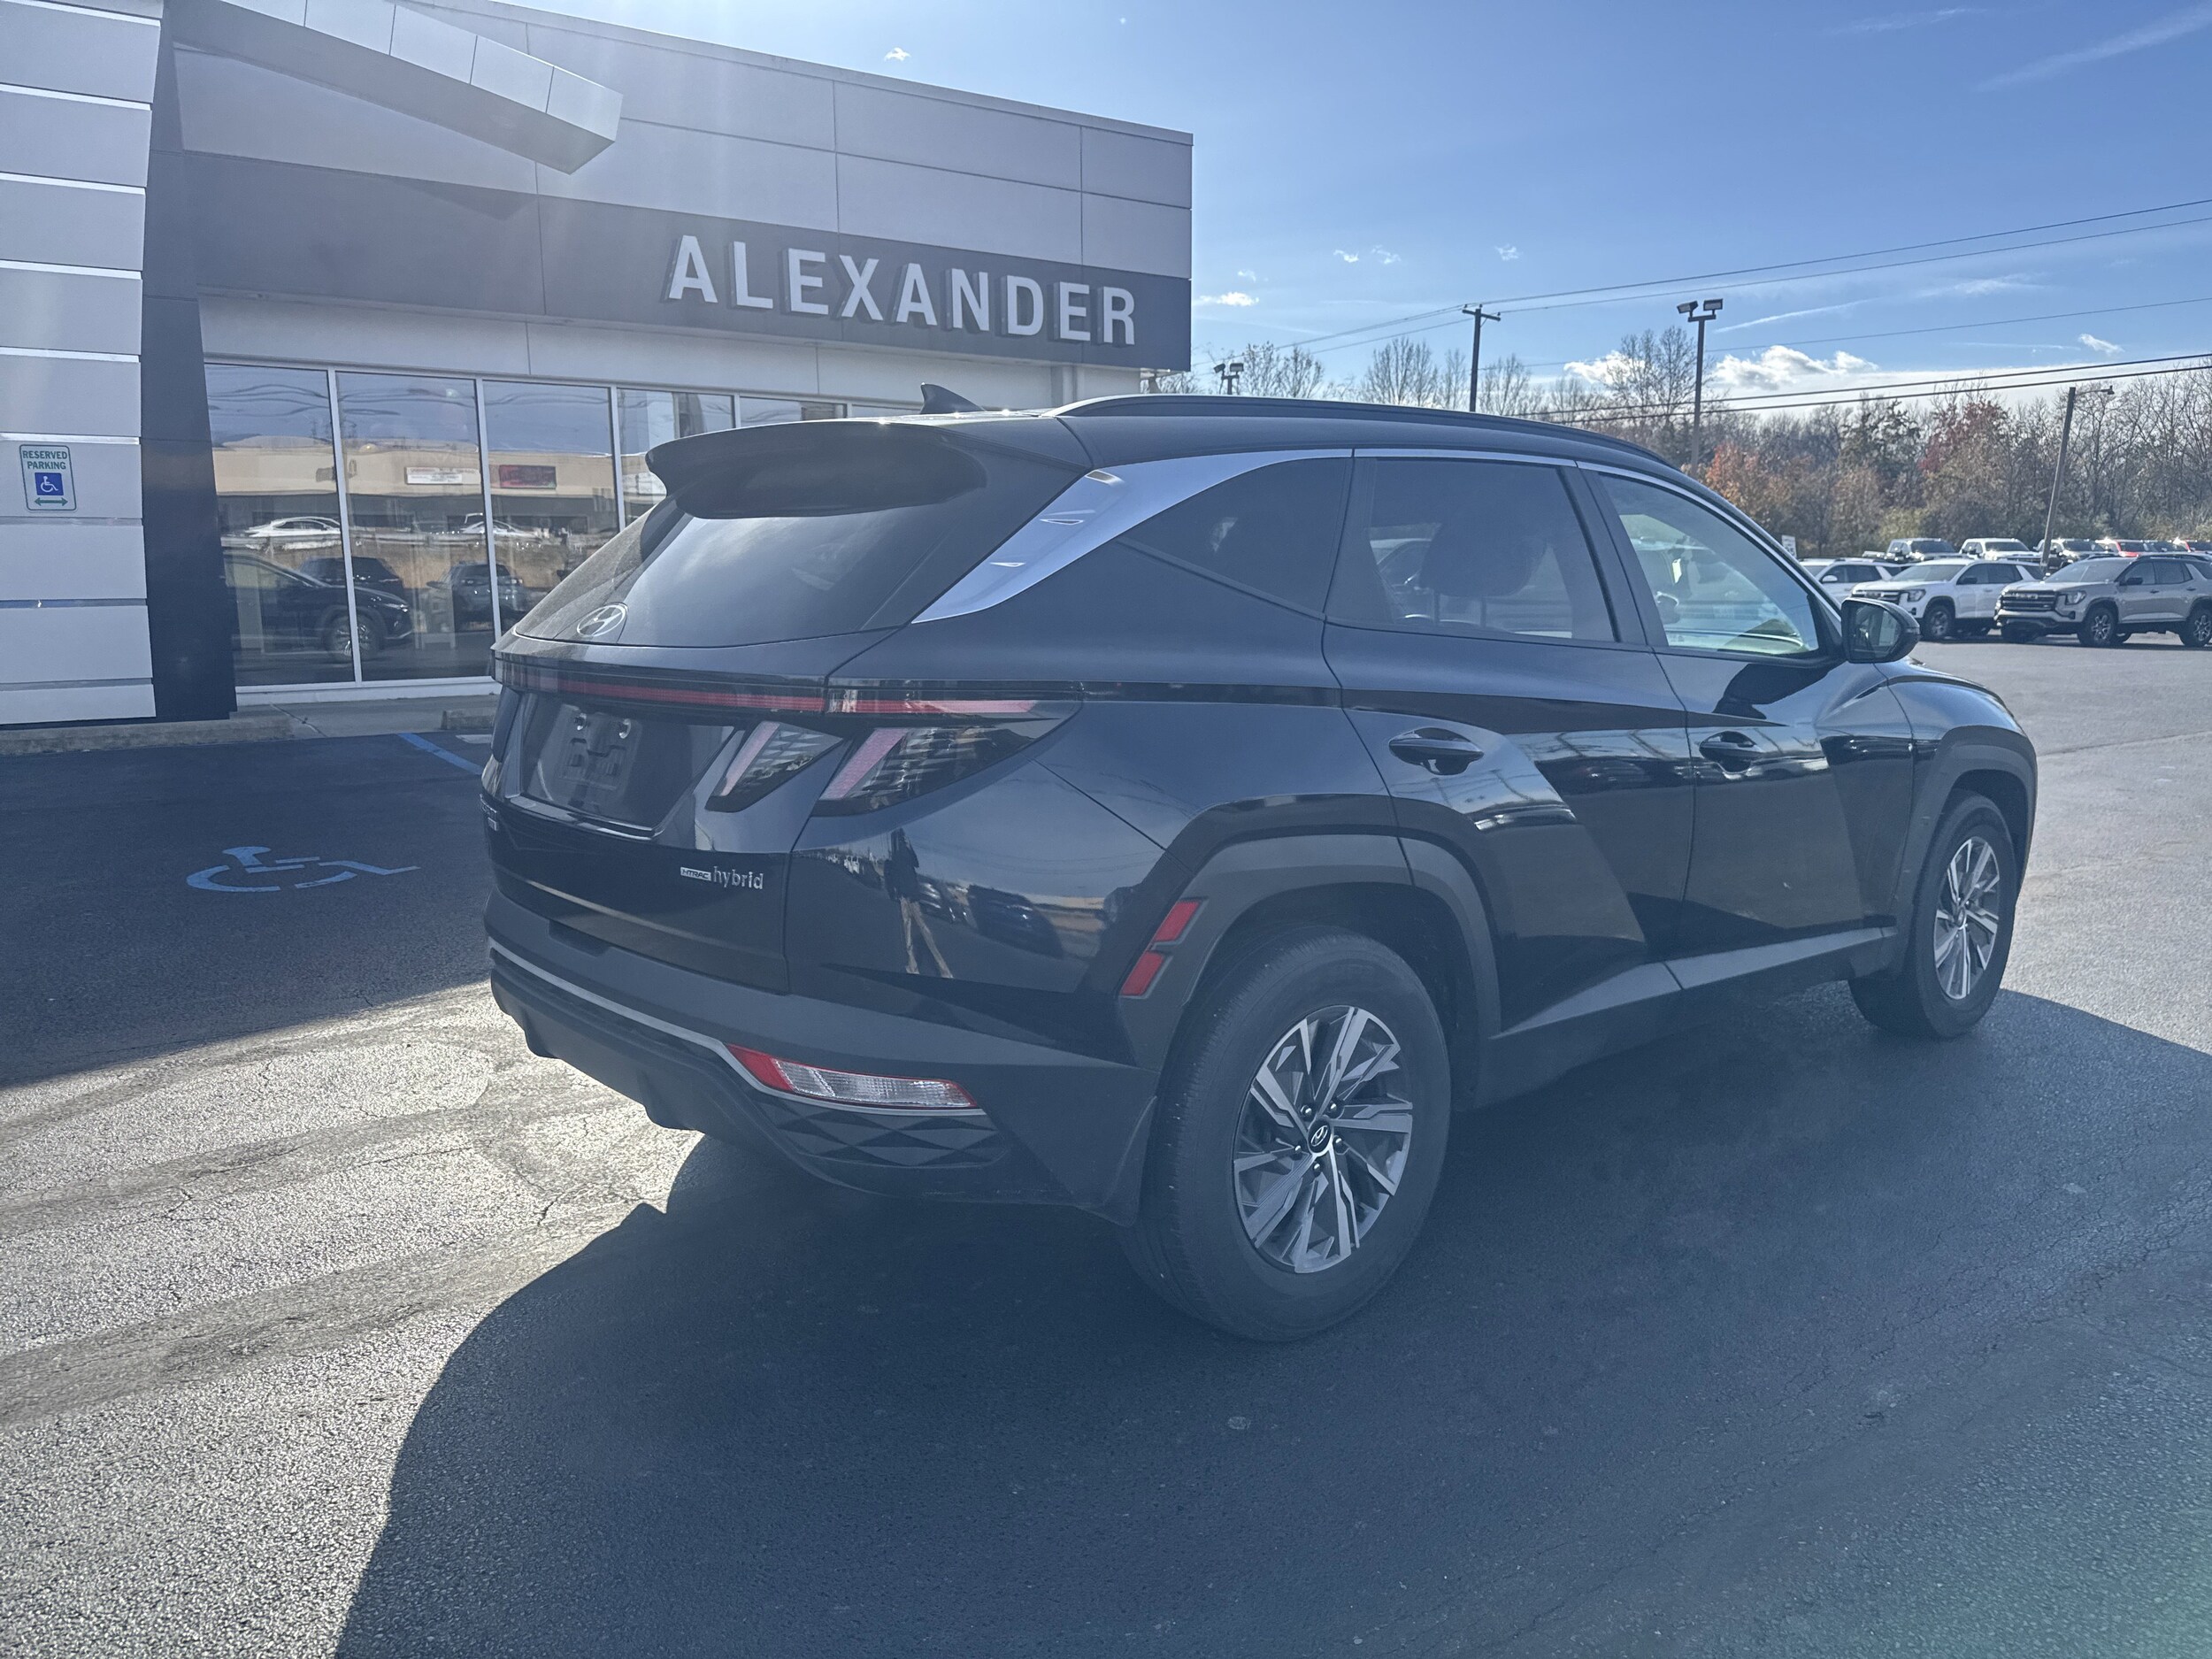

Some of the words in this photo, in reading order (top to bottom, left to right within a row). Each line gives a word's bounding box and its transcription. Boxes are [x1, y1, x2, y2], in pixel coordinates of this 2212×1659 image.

[667, 234, 1135, 345] ALEXANDER
[22, 450, 68, 459] RESERVED
[27, 461, 66, 470] PARKING
[681, 868, 710, 880] HTRAC
[713, 866, 764, 889] hybrid
